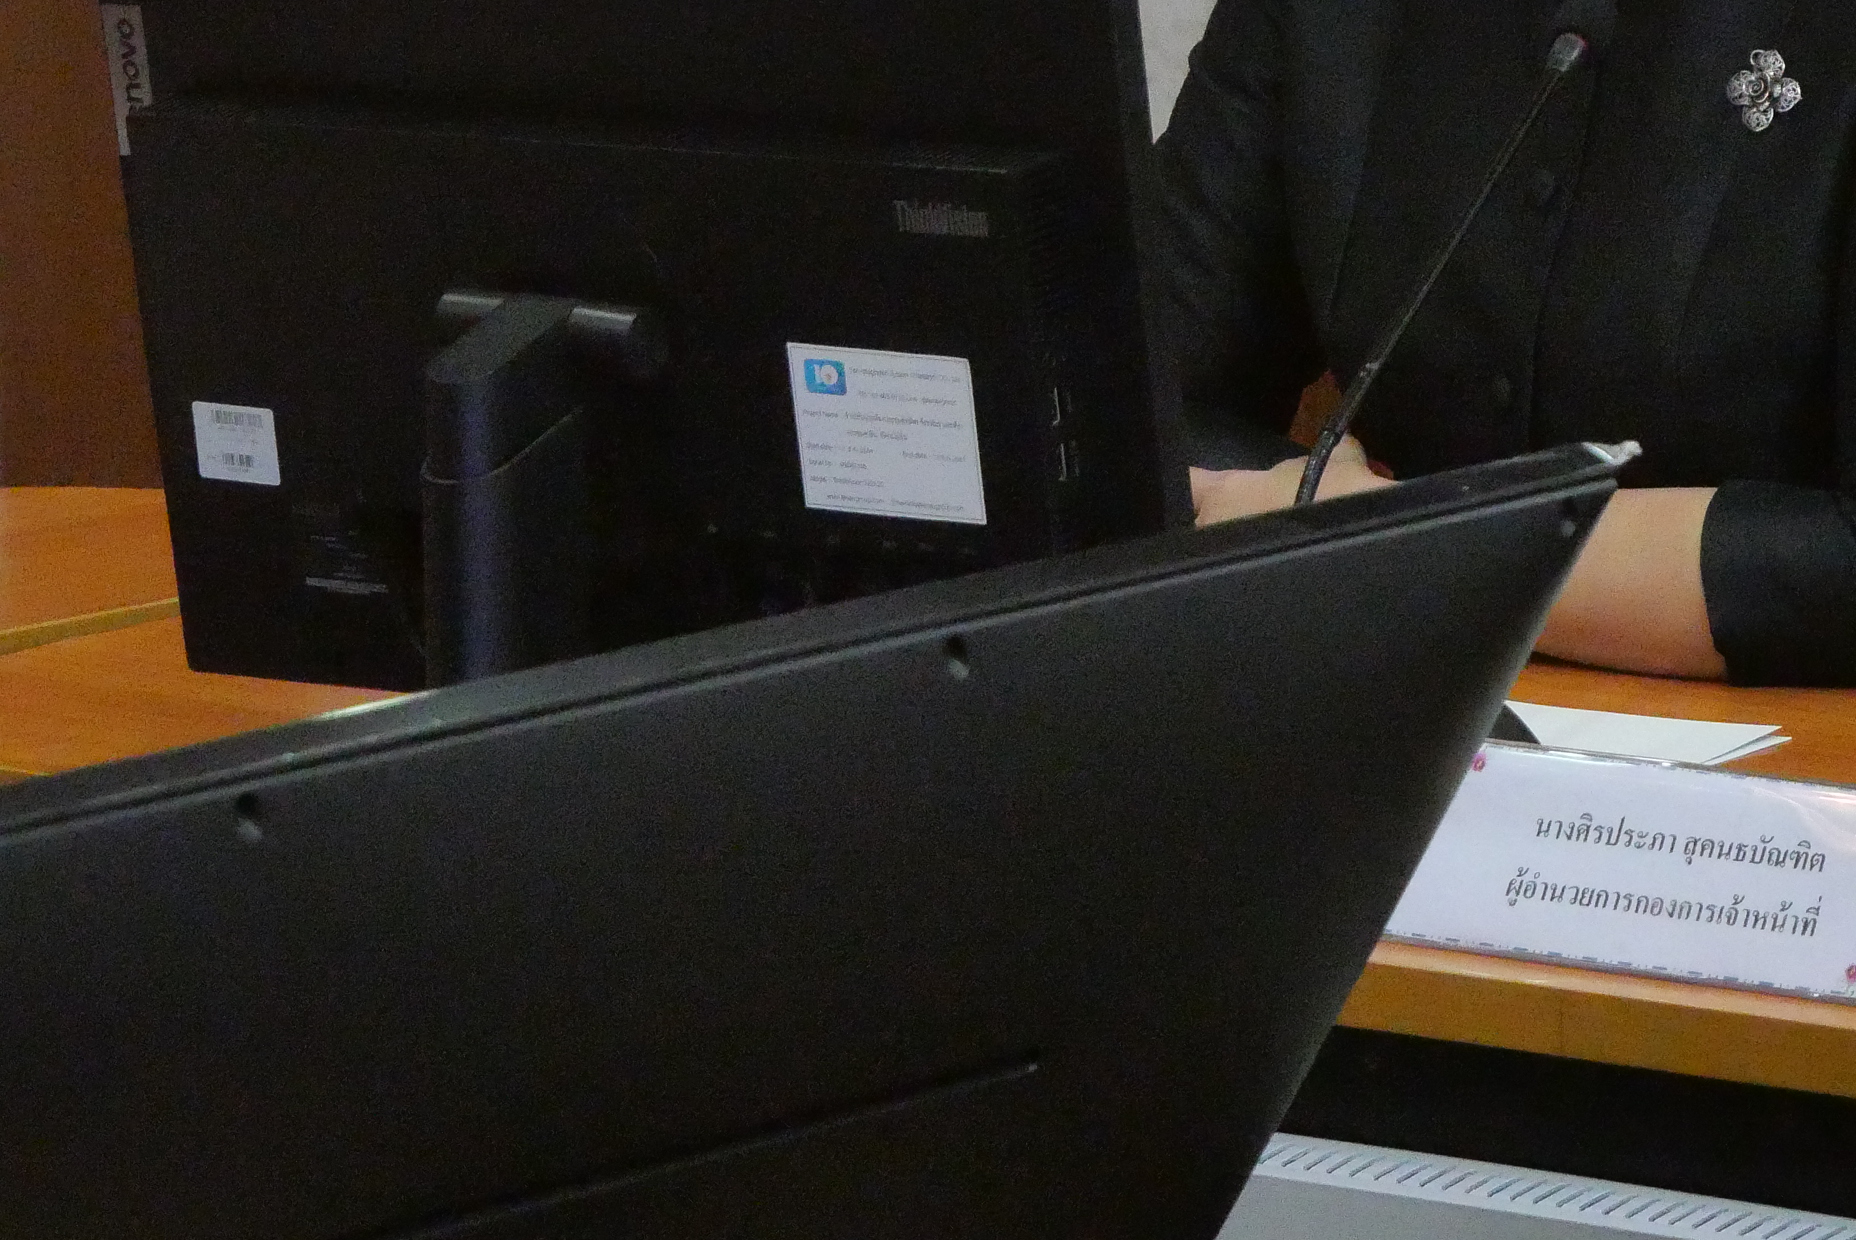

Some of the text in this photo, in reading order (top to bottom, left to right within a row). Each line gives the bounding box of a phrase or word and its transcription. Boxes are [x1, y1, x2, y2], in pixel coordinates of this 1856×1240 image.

[117, 18, 144, 113] novo
[1535, 812, 1827, 873] นางศิรประภา สุคนธบัณฑิต
[1505, 866, 1824, 938] ผู้อำนวยการกองการเจ้าหน้าที่
